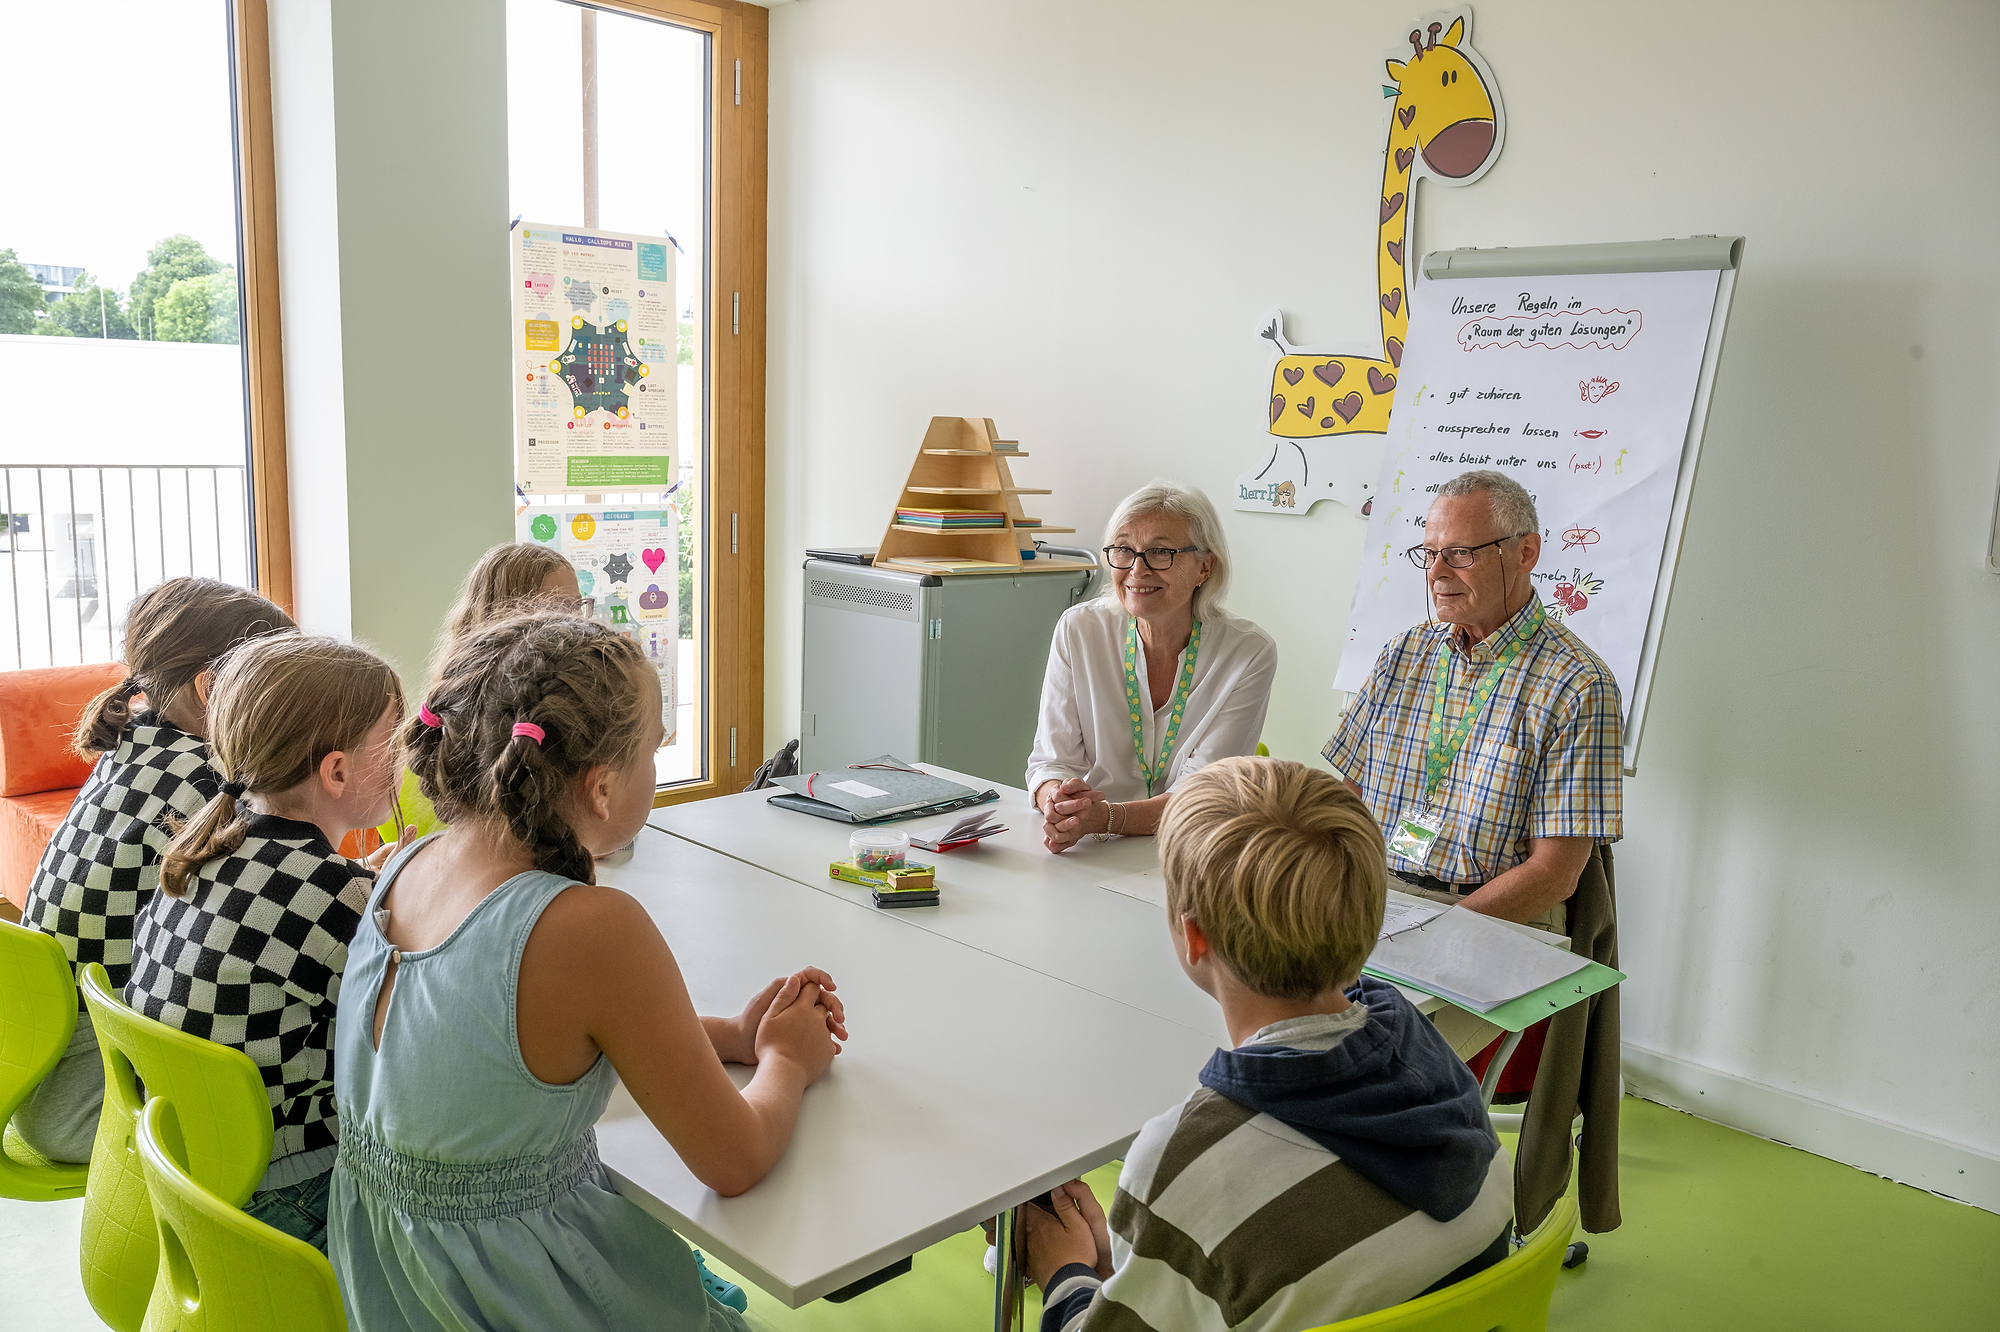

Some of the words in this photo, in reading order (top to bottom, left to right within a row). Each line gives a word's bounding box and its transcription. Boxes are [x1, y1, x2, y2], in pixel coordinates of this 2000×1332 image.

[1451, 296, 1497, 314] Unsere
[1518, 292, 1558, 314] Regeln
[1567, 296, 1582, 310] im
[1506, 324, 1525, 337] der
[1528, 322, 1562, 342] guten
[1446, 387, 1470, 405] gut
[1476, 387, 1522, 400] zuhören
[1437, 422, 1511, 440] aussprechen
[1522, 422, 1560, 439] lassen
[1429, 451, 1454, 464] alles
[1458, 452, 1492, 465] bleibt
[1496, 454, 1527, 467] unter
[1536, 460, 1557, 470] uns
[1531, 568, 1567, 583] mpeln
